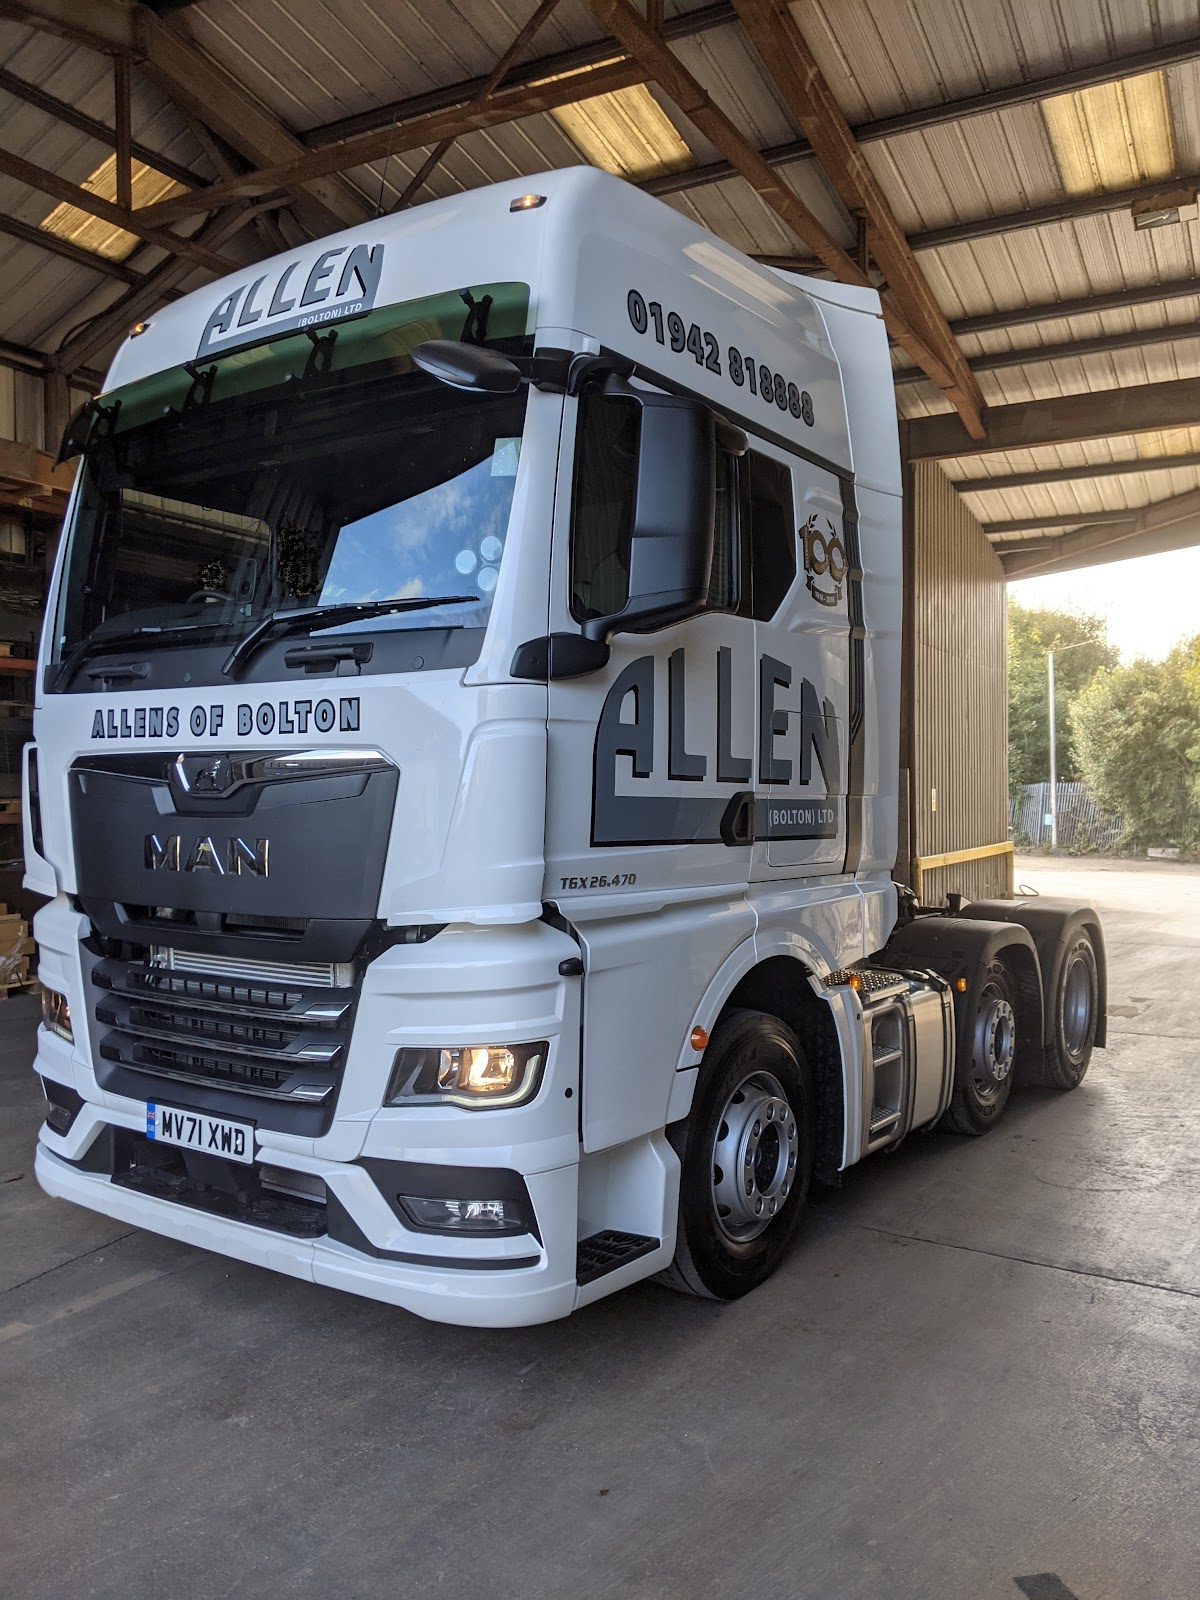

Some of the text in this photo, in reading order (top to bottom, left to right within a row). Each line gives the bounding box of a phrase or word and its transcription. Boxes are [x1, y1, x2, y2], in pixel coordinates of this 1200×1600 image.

[195, 243, 385, 359] ALLEN
[297, 302, 363, 328] (BOLTON) LTD
[627, 288, 815, 428] 01942 818888
[90, 696, 361, 739] ALLENS OF BOLTON
[590, 645, 841, 815] ALLEN
[769, 809, 834, 827] (BOLTON) LTD
[144, 833, 271, 878] MAN
[589, 873, 637, 889] 26.470
[161, 1110, 246, 1157] MV71 XWD
